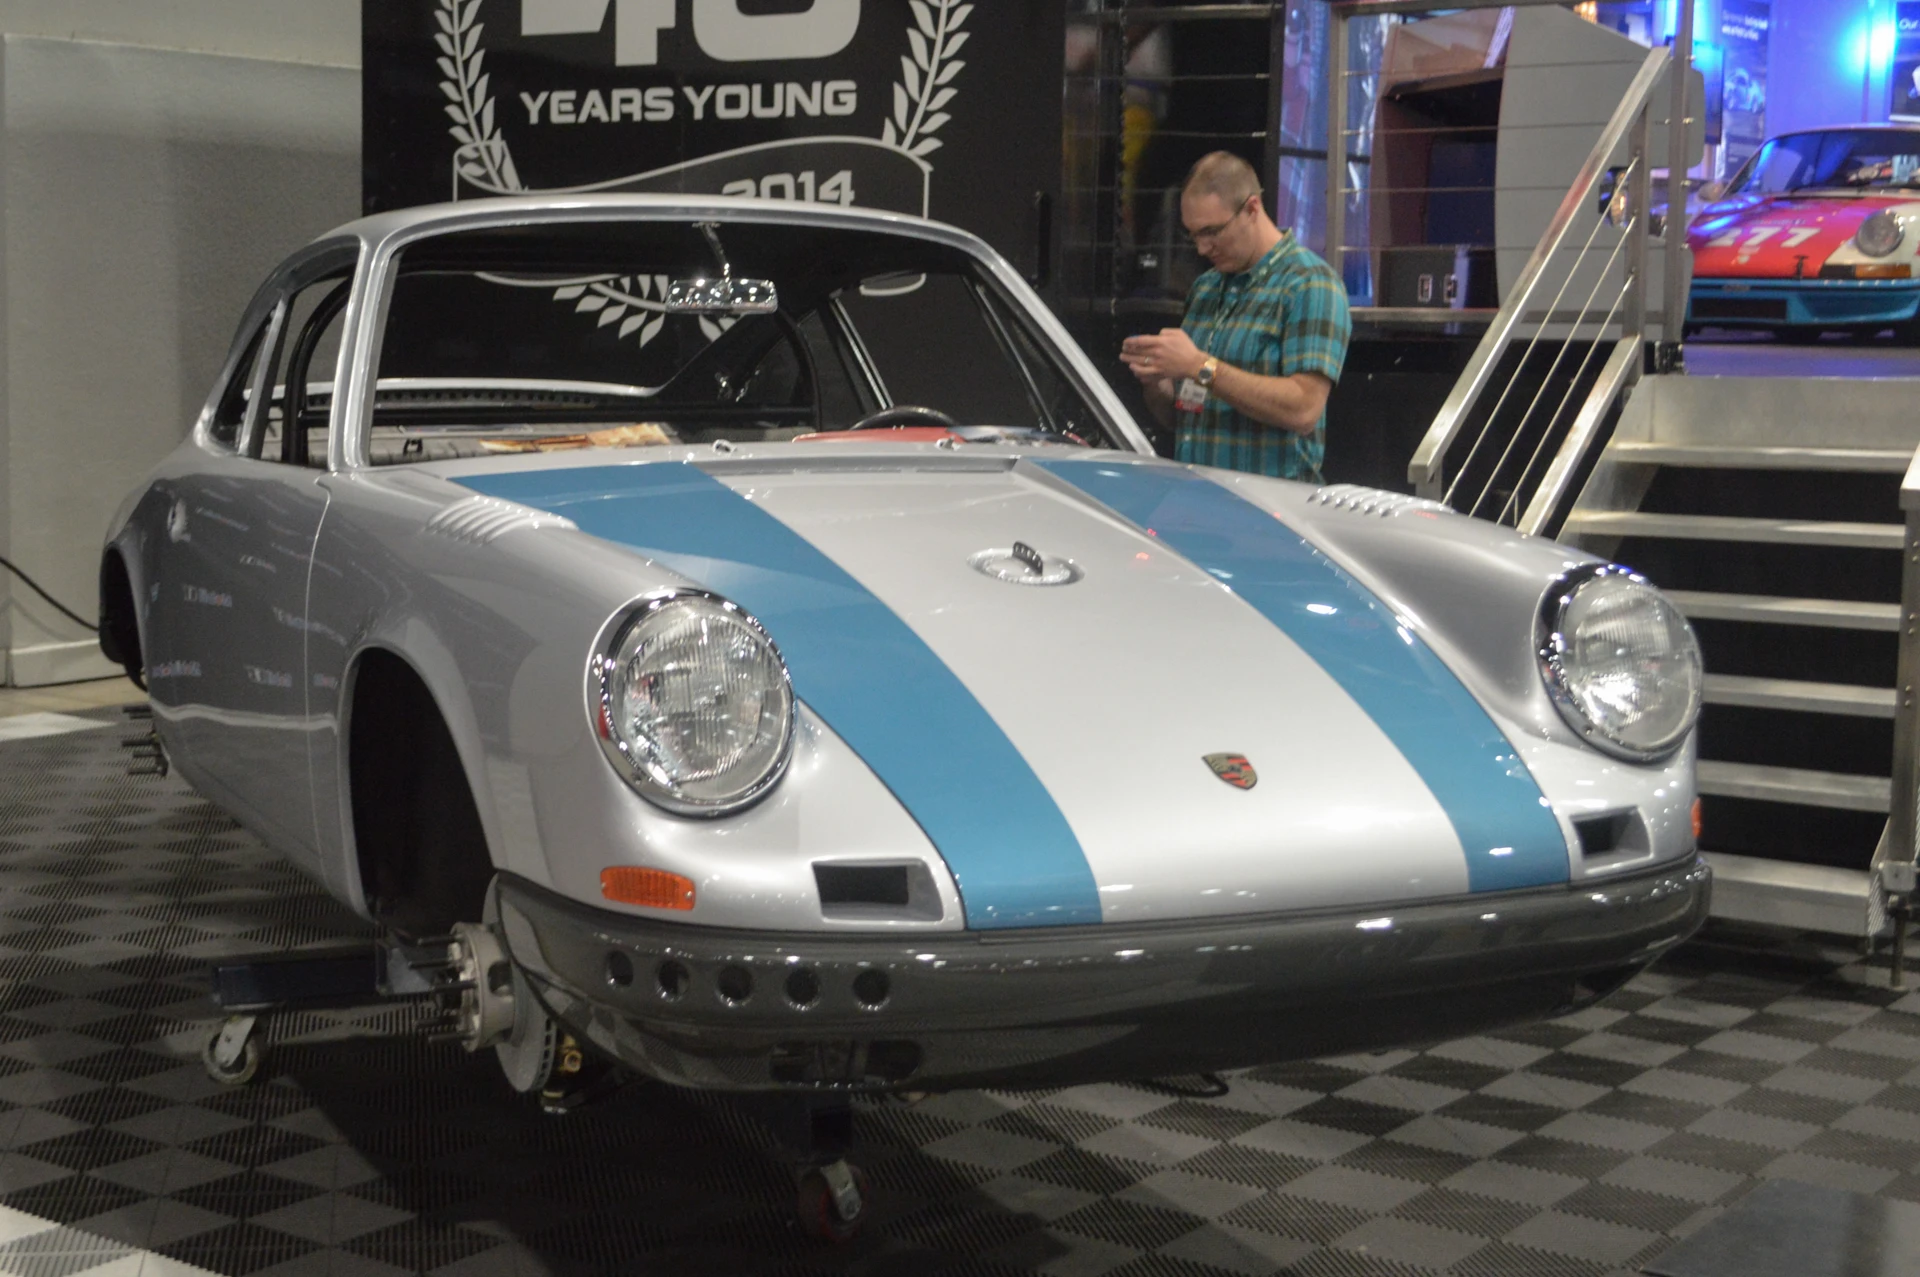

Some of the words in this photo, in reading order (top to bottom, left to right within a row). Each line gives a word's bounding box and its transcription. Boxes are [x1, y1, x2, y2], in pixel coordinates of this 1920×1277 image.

[519, 86, 675, 125] YEARS
[682, 80, 857, 120] YOUNG
[1704, 226, 1821, 248] 277
